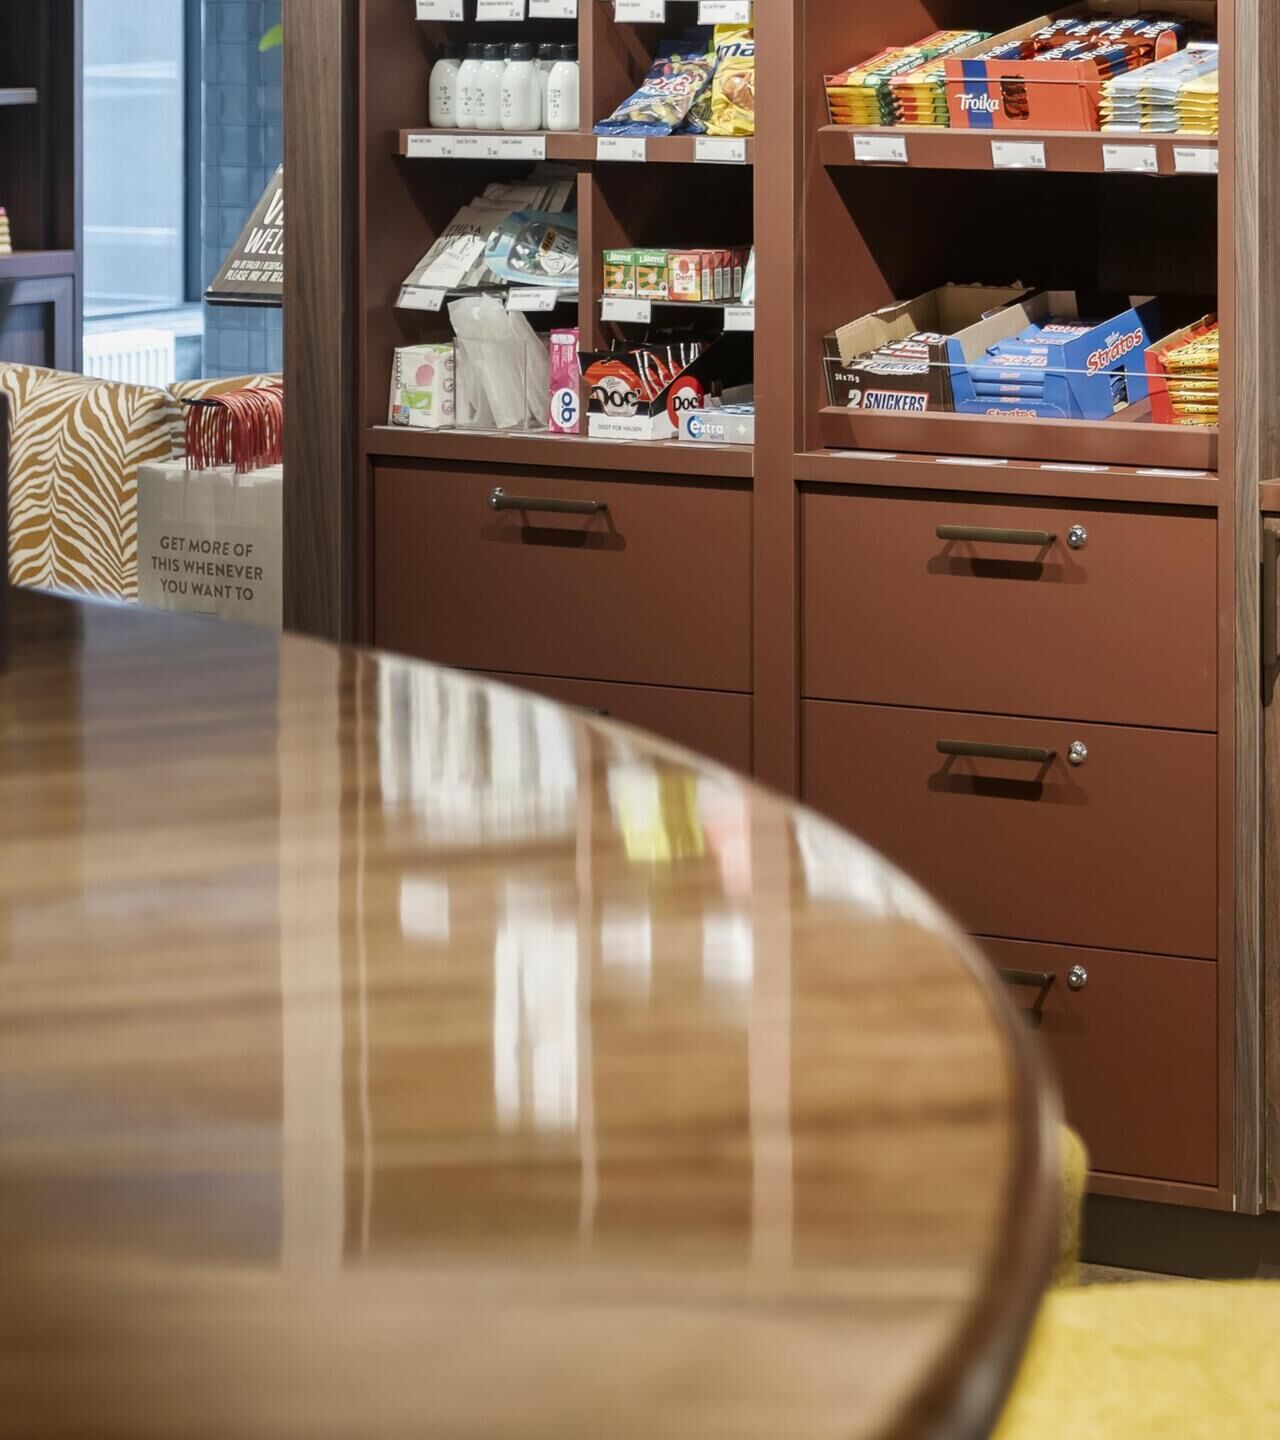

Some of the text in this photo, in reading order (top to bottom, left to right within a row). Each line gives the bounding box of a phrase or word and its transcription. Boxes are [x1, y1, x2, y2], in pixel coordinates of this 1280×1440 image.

[954, 93, 1000, 113] Troika
[676, 273, 693, 281] Dent
[1087, 328, 1144, 376] Stratos
[846, 389, 925, 412] 2 SNICKERS
[690, 417, 724, 436] extra
[160, 536, 253, 557] GET MORE OF
[151, 556, 263, 580] THIS WHENEVER
[160, 578, 254, 601] YOU WANT TO
